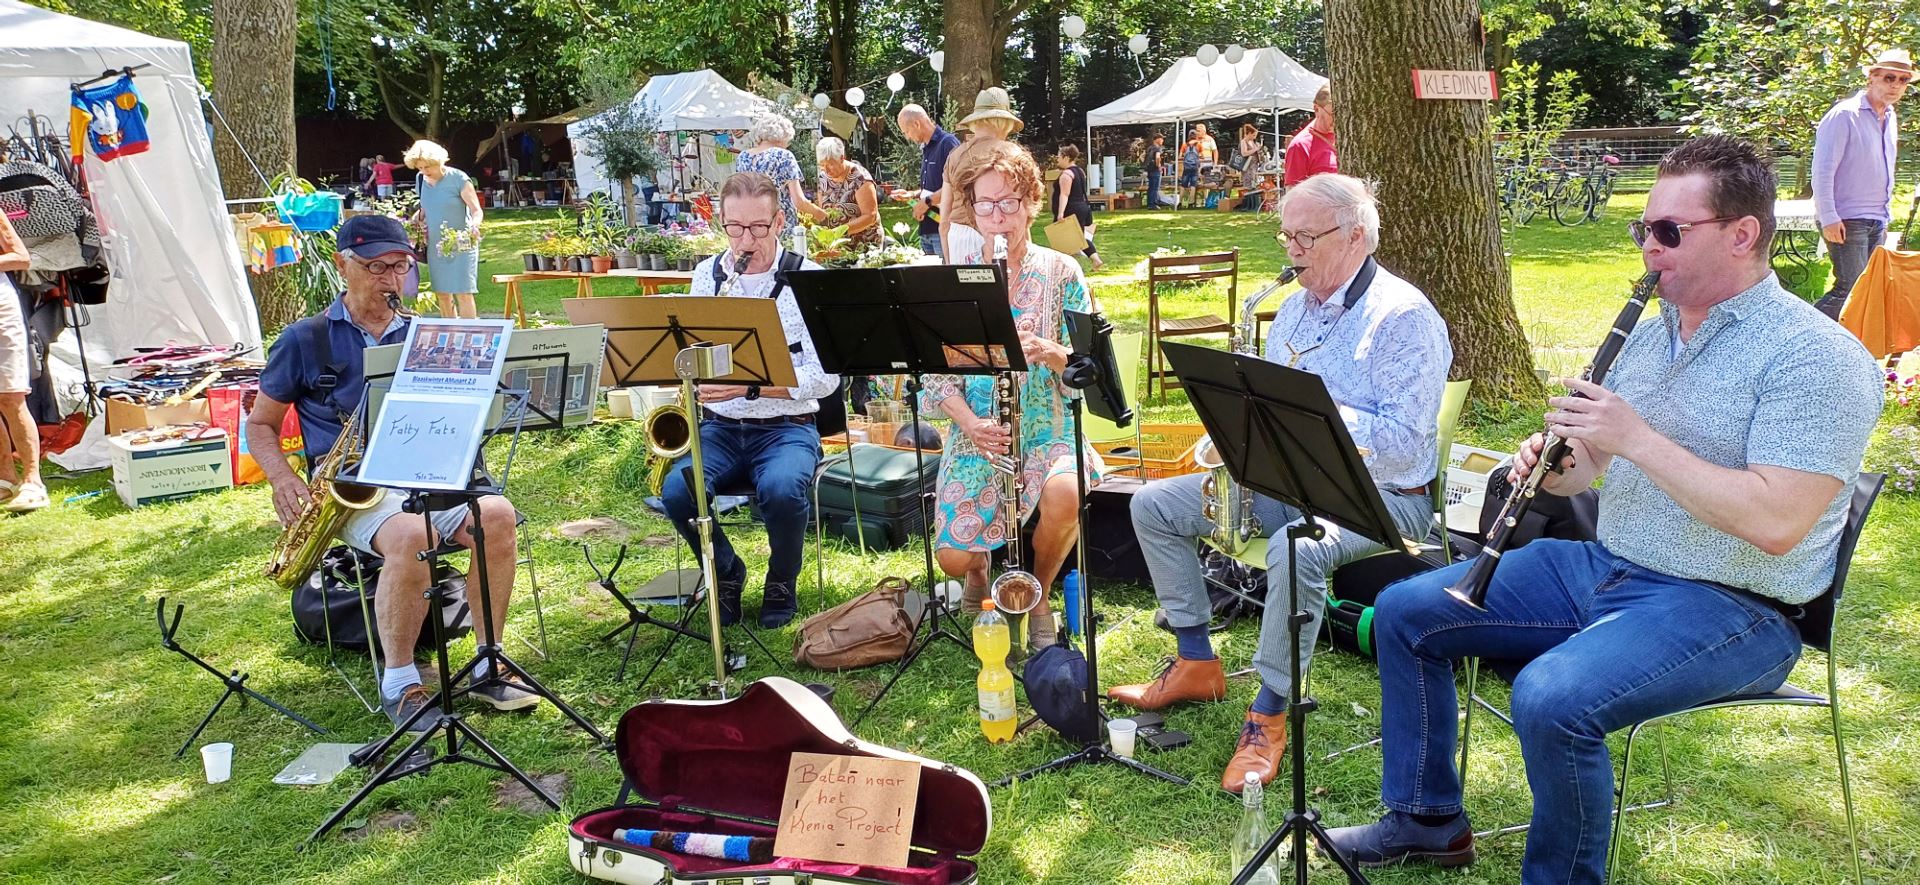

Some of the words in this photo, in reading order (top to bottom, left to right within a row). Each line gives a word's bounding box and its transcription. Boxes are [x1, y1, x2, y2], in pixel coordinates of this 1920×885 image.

[1424, 74, 1488, 95] KLEDING
[428, 416, 456, 435] Fats
[794, 763, 857, 785] Baten
[865, 777, 905, 787] naar
[818, 789, 845, 804] het
[790, 802, 835, 834] Kenia
[835, 806, 901, 840] Project
